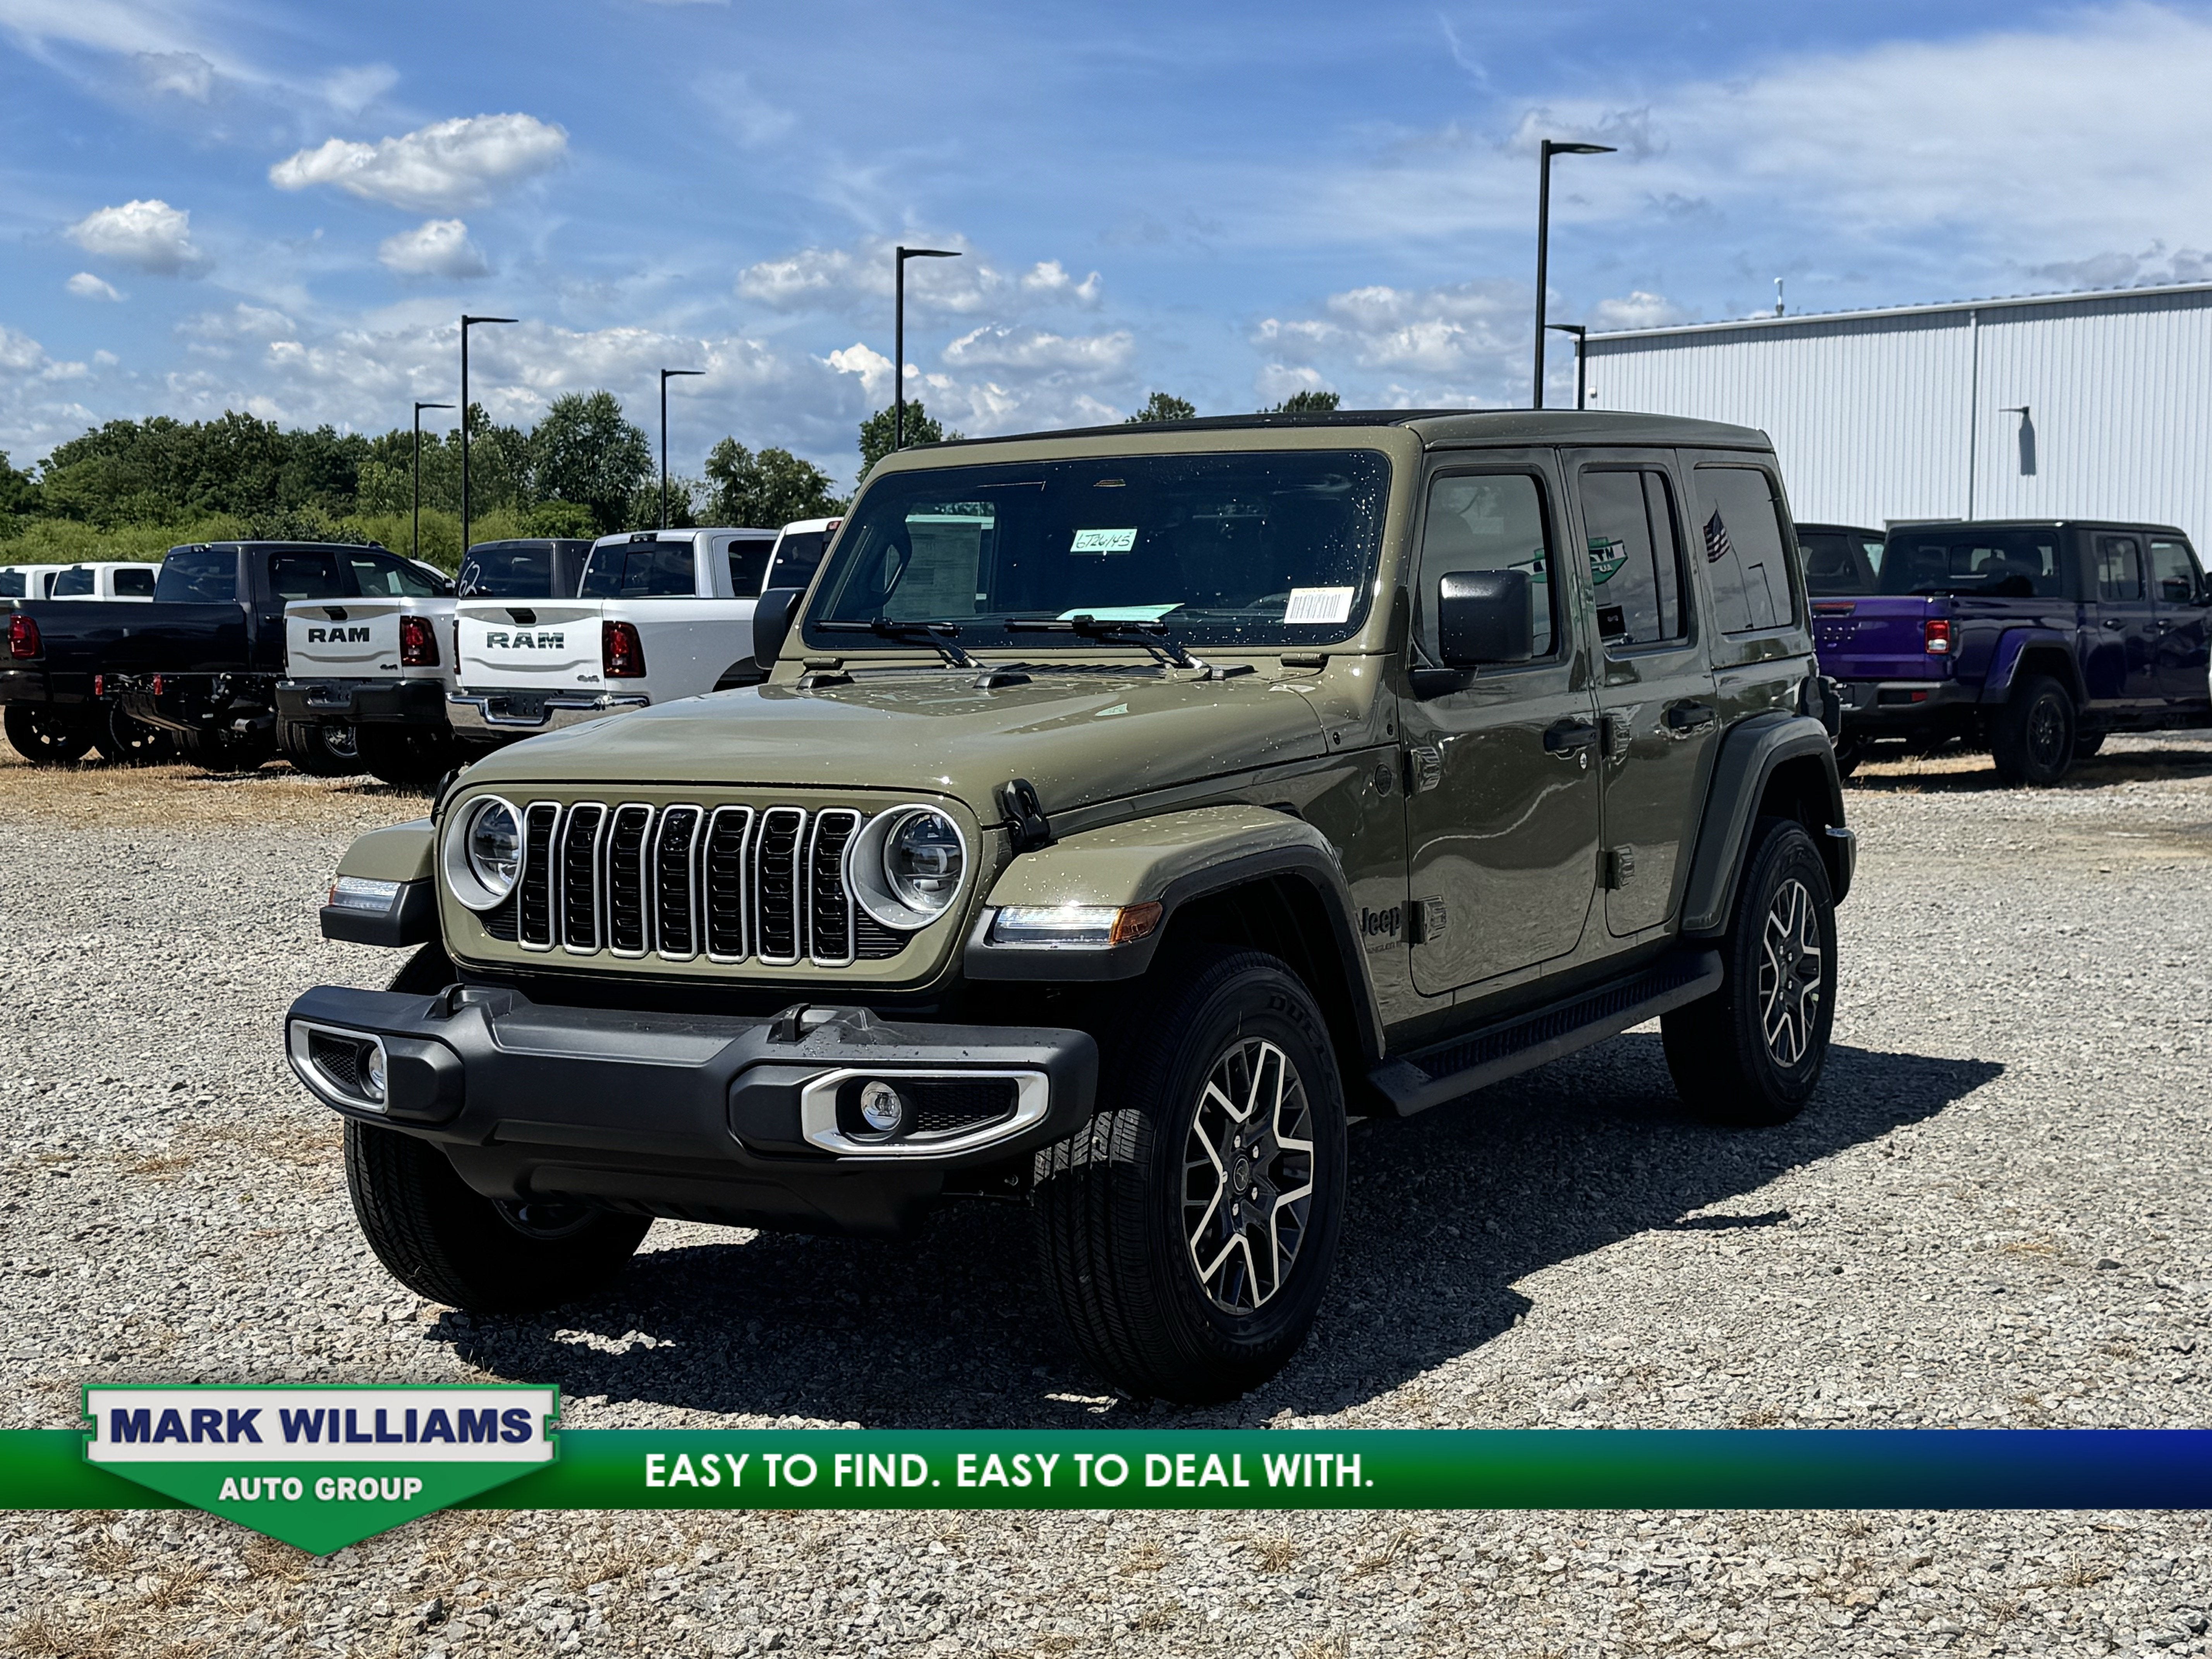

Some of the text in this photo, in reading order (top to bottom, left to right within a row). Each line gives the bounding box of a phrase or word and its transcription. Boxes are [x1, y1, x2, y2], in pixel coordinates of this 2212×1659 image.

[308, 627, 370, 643] RAM
[486, 632, 564, 649] RAM
[1361, 906, 1401, 937] Jeep
